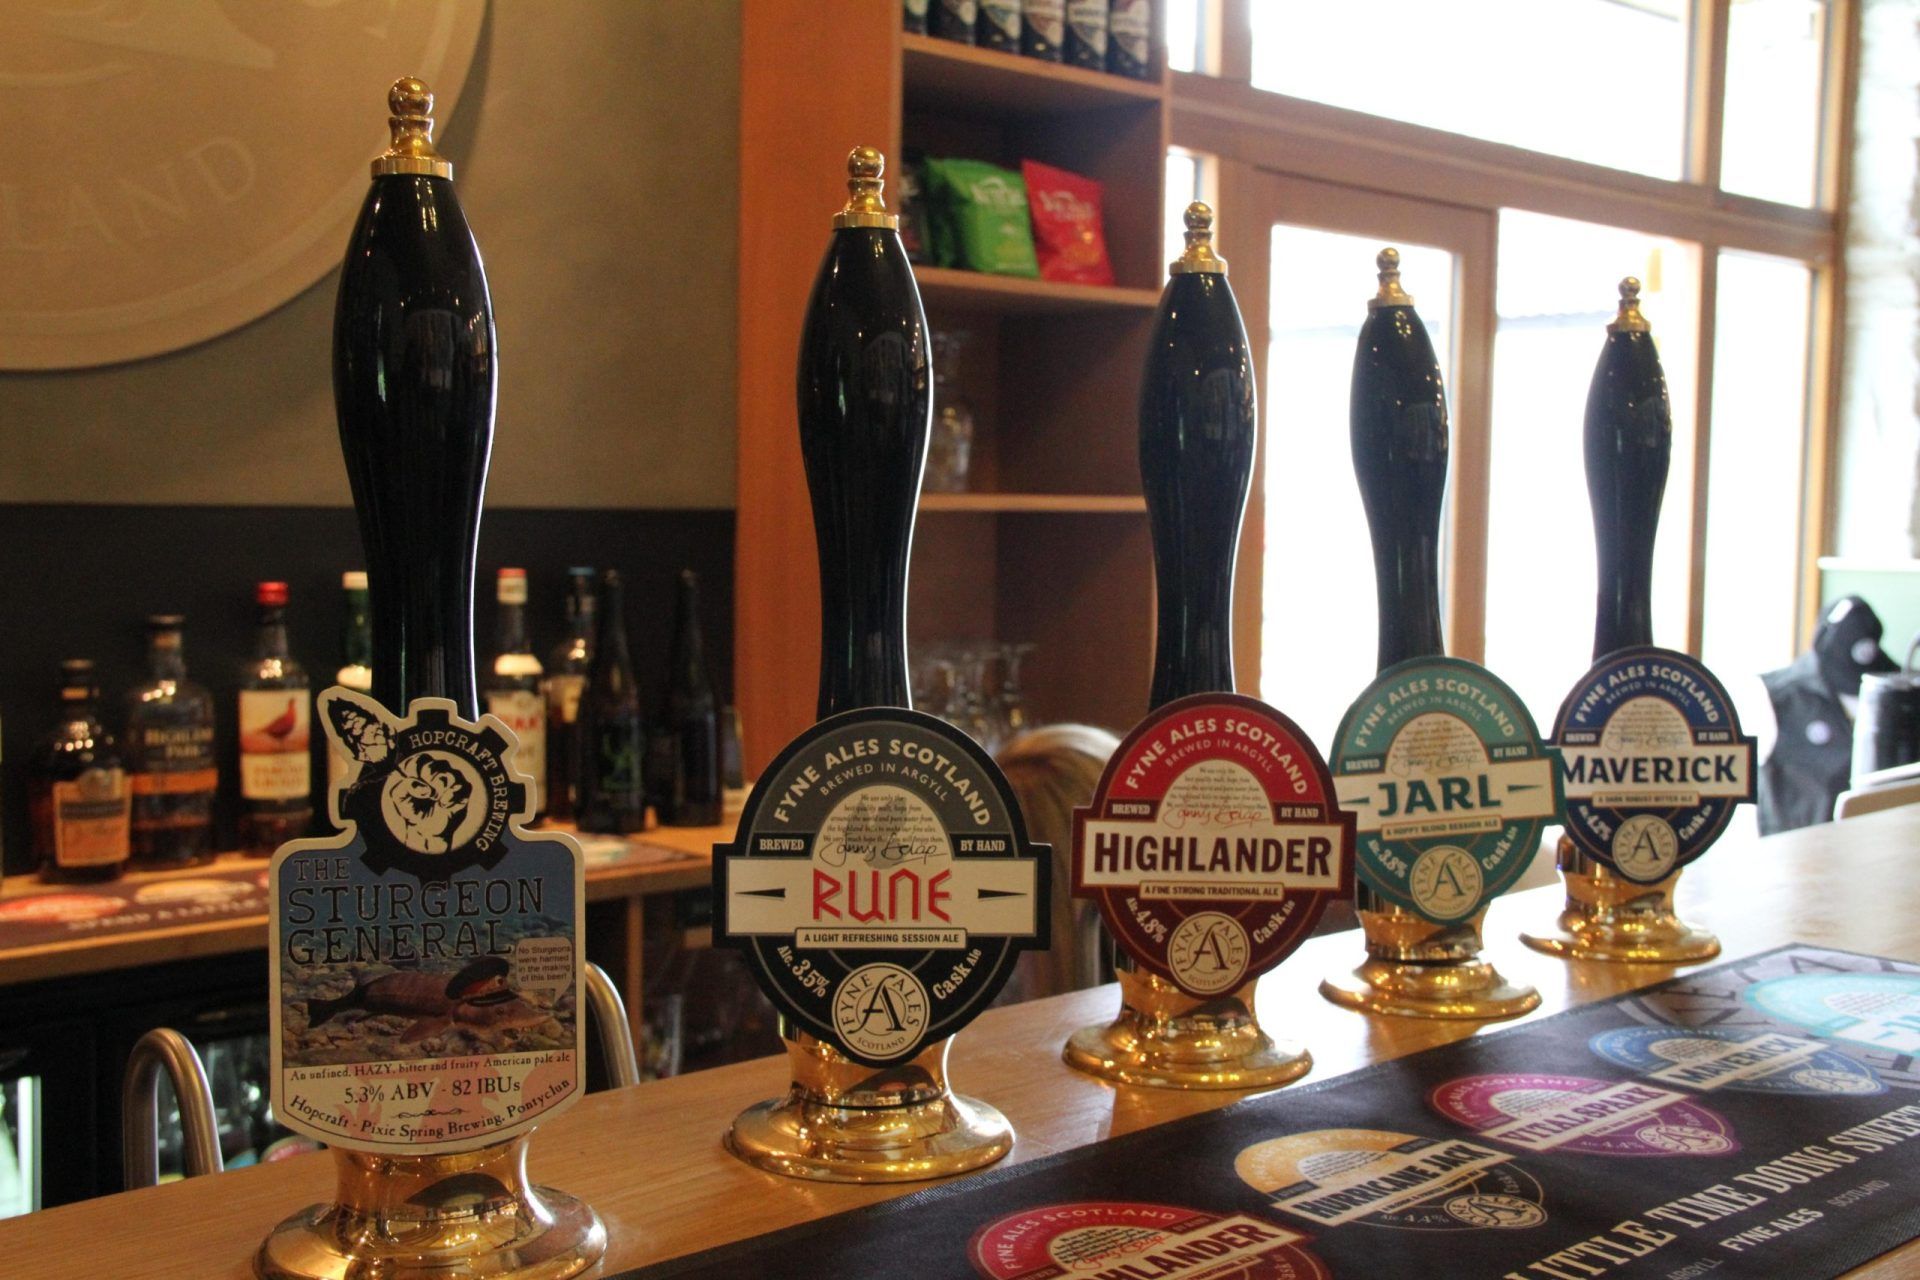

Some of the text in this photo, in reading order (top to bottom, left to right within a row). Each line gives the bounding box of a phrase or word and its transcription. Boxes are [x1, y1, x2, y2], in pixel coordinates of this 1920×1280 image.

[1354, 703, 1388, 749] FYNE
[1388, 678, 1429, 706] ALES
[1435, 678, 1517, 738] SCOTLAND
[1574, 683, 1606, 723] FYNE
[1608, 664, 1646, 686] ALES
[1651, 664, 1720, 723] SCOTLAND
[1126, 741, 1167, 790] FYNE
[1170, 718, 1218, 744] ALES
[1224, 719, 1308, 795] SCOTLAND
[1164, 738, 1273, 774] BREWED IN ARGYLL
[1562, 754, 1738, 784] MAVERICK
[408, 729, 508, 852] HOPCRAFT BREWING
[774, 739, 992, 826] FYNE ALES SCOTLAND
[819, 762, 948, 802] BREWED IN ARGYLL
[1378, 774, 1502, 817] JARL
[1112, 803, 1319, 819] BREWED BY HAND
[759, 838, 1006, 851] BREWED BY HAND
[1094, 832, 1333, 876] HIGHLANDER
[293, 857, 350, 882] THE
[1152, 886, 1170, 894] FINE
[1172, 886, 1206, 895] STRONG
[1207, 887, 1261, 895] TRADITIONAL
[1262, 888, 1279, 896] ALE
[287, 875, 545, 925] STURGEON
[812, 867, 953, 924] RUNE
[286, 919, 512, 965] GENERAL
[804, 933, 959, 943] A LIGHT REFRESHING SESSION ALE
[1136, 909, 1168, 943] 4.8%
[1252, 912, 1286, 944] Cask
[777, 945, 831, 998] Alc. 3.5%
[932, 948, 983, 1000] Cask Ale
[839, 973, 922, 1027] FYNE ALES
[856, 1035, 906, 1051] SCOTLAND
[1667, 1037, 1808, 1083] MAVERICK
[290, 1070, 306, 1081] An
[398, 1064, 427, 1073] bitter
[430, 1063, 447, 1071] and
[450, 1061, 479, 1070] fruity
[483, 1057, 531, 1068] American
[534, 1053, 553, 1066] pale
[556, 1052, 570, 1062] ale
[290, 1094, 349, 1128] Hopcraft
[361, 1119, 396, 1136] Pixie
[399, 1124, 444, 1140] Spring
[506, 1079, 570, 1118] Pontyclun
[344, 1084, 385, 1104] 5.3%
[391, 1081, 434, 1100] ABV
[452, 1079, 471, 1096] 82
[477, 1076, 520, 1094] IBUs
[1290, 1164, 1442, 1219] HURRICANE
[1420, 1142, 1496, 1172] JACK
[1002, 1219, 1041, 1242] ALES
[1042, 1207, 1176, 1222] SCOTLAND
[1503, 1220, 1678, 1280] ITTLE
[1643, 1183, 1768, 1229] TIME
[1732, 1145, 1860, 1194] DOING
[1719, 1226, 1781, 1252] FYNE
[1769, 1208, 1824, 1232] ALES
[1827, 1180, 1890, 1207] SCOTLAND
[997, 1243, 1022, 1271] FYNE
[1081, 1224, 1281, 1280] HLANDER
